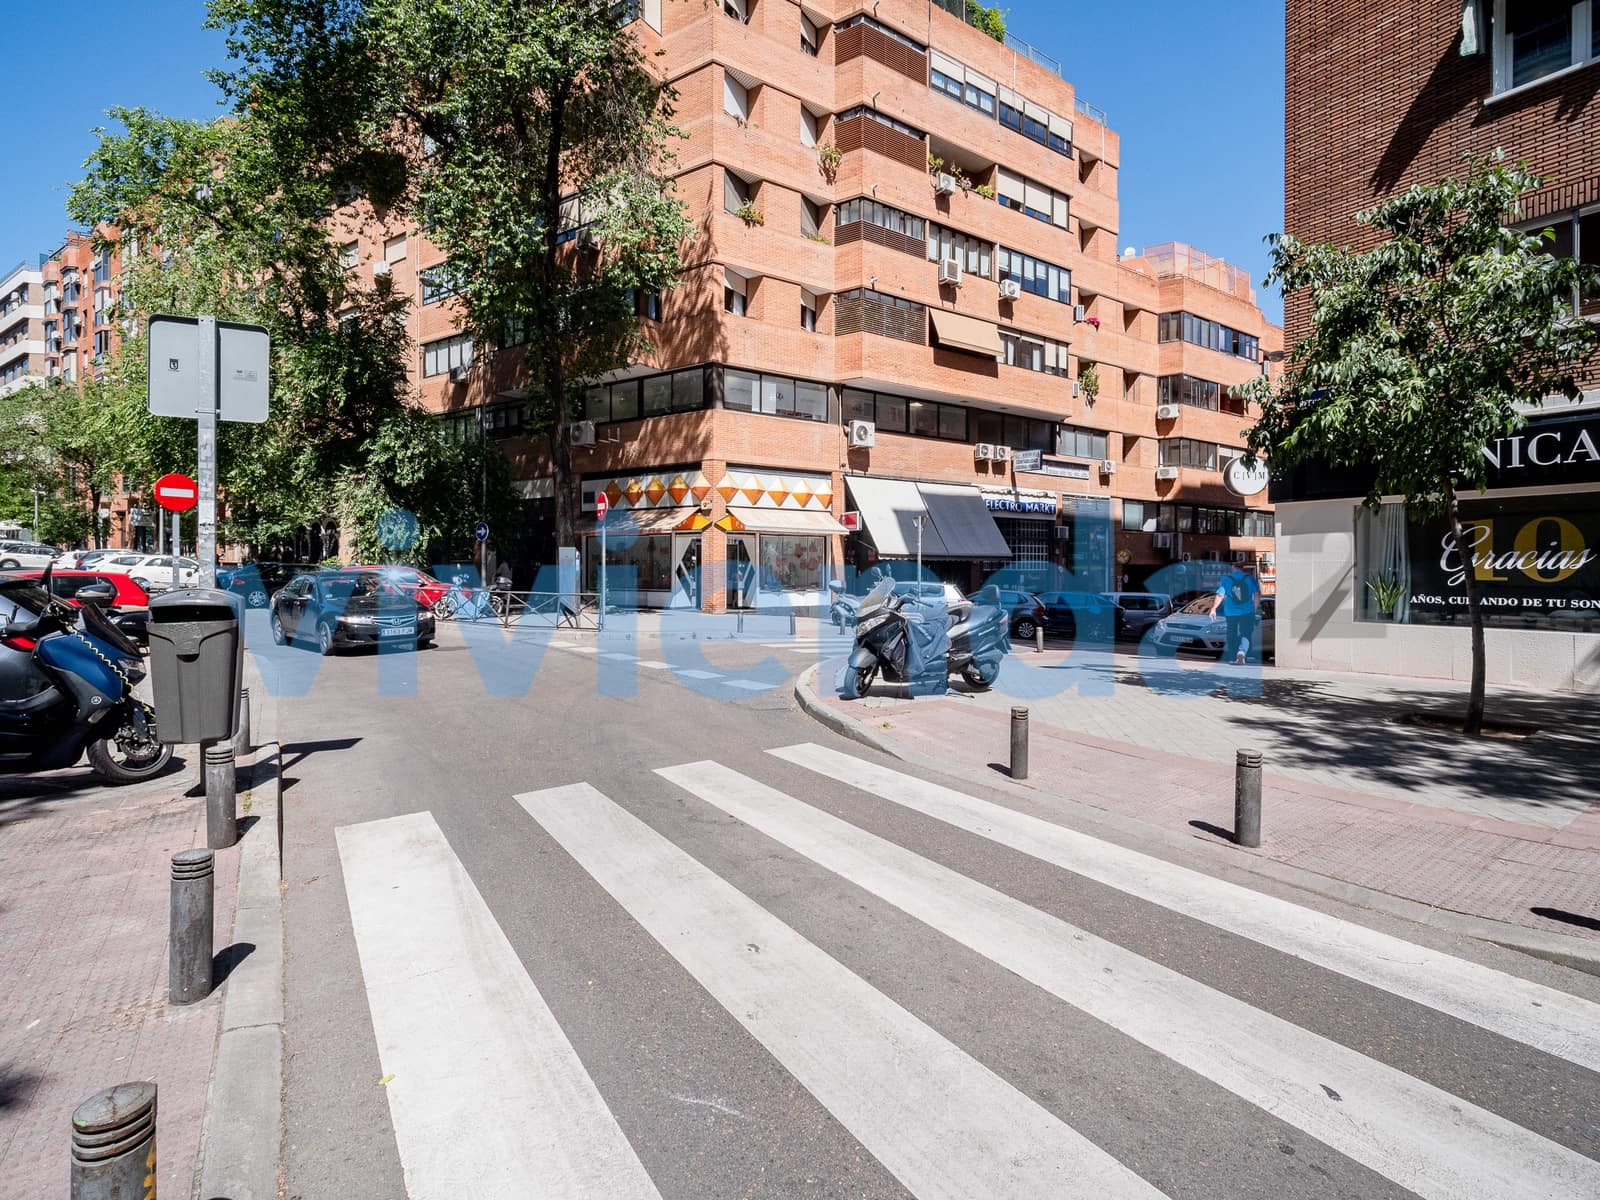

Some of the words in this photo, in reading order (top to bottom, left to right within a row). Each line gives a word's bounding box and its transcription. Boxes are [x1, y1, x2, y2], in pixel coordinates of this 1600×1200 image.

[985, 499, 1022, 512] ELECTRO
[1025, 502, 1056, 514] MARKT
[1439, 525, 1598, 586] Gracias
[1409, 593, 1446, 606] AÑOS,
[1448, 595, 1519, 607] CUIANDO
[1521, 597, 1543, 607] DE
[1545, 598, 1567, 608] TU
